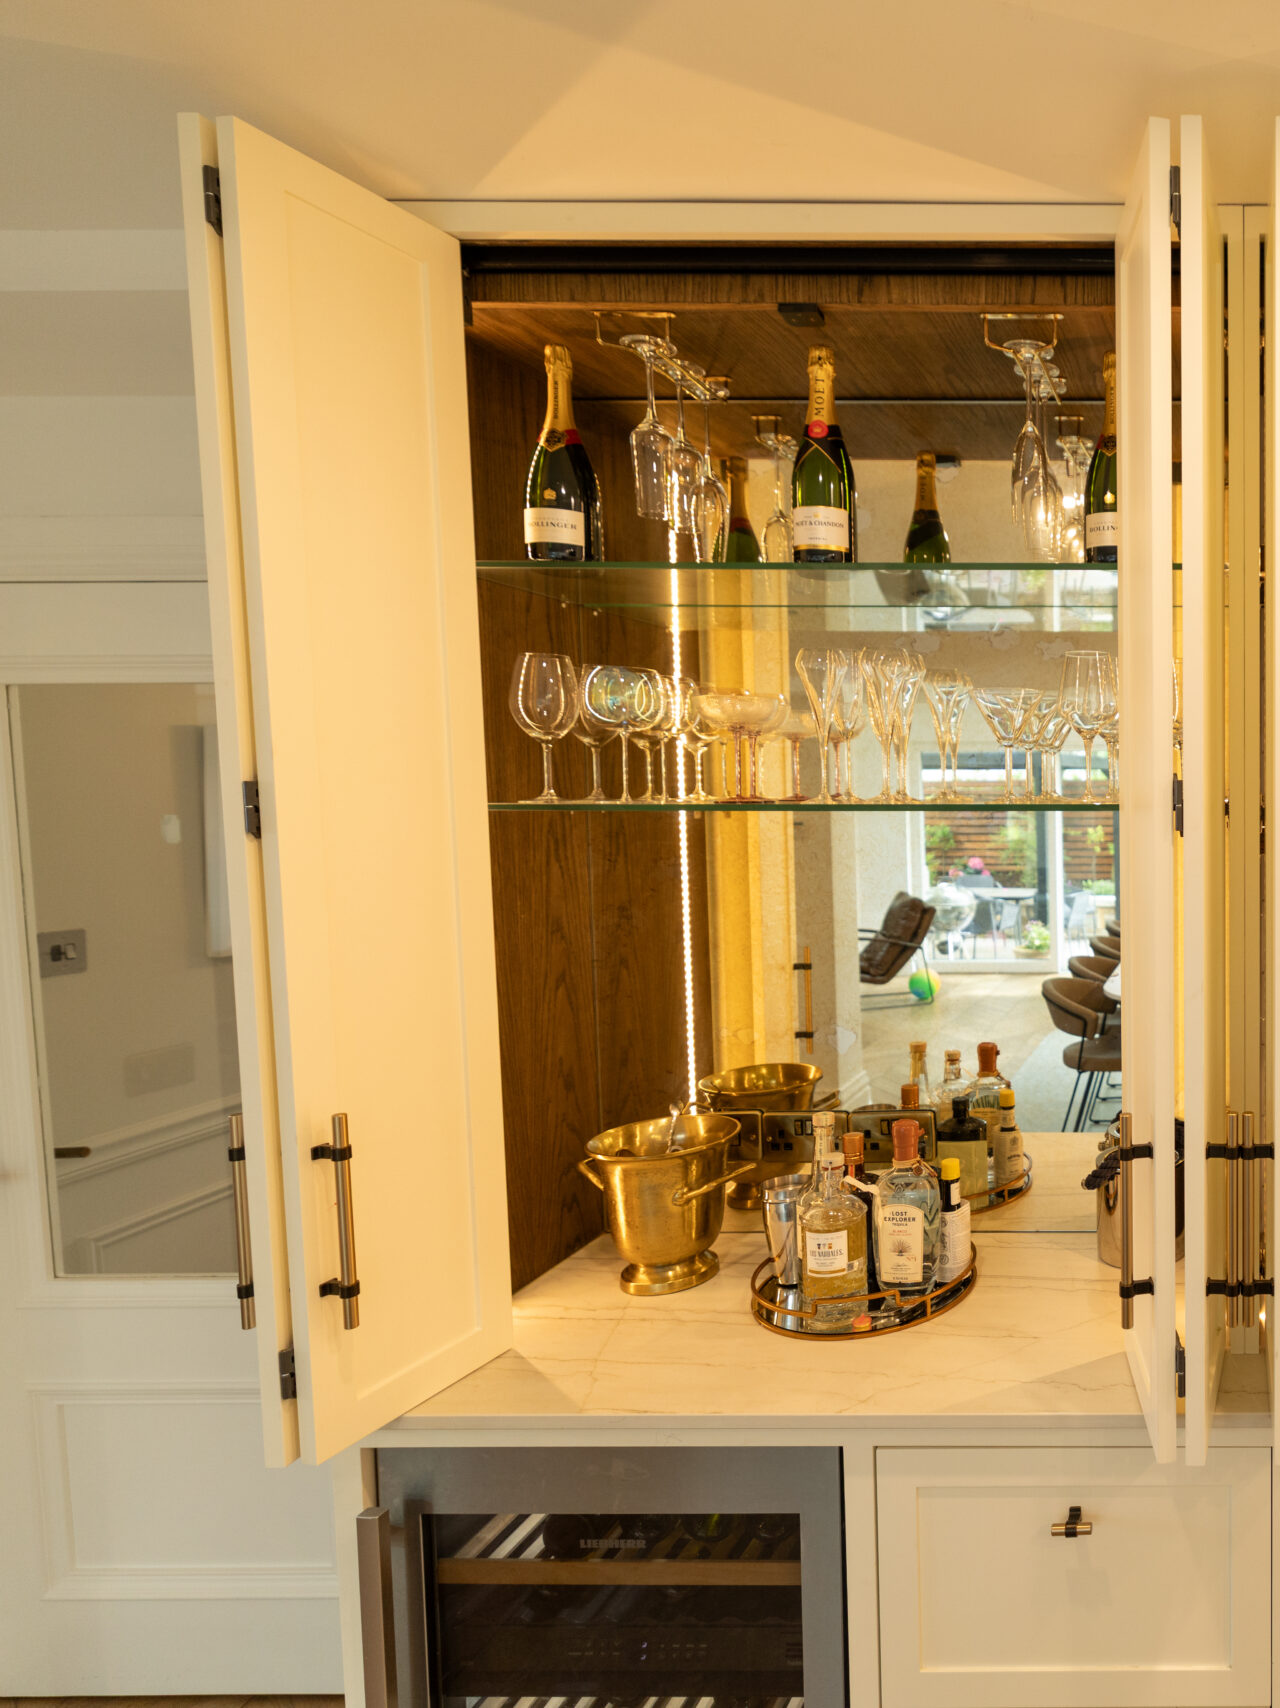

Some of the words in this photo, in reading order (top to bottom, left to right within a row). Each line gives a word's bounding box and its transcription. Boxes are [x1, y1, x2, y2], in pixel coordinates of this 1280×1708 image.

[813, 520, 844, 529] CHANDON
[1089, 524, 1119, 533] BOLLIN
[579, 1538, 647, 1549] LIEBHERR
